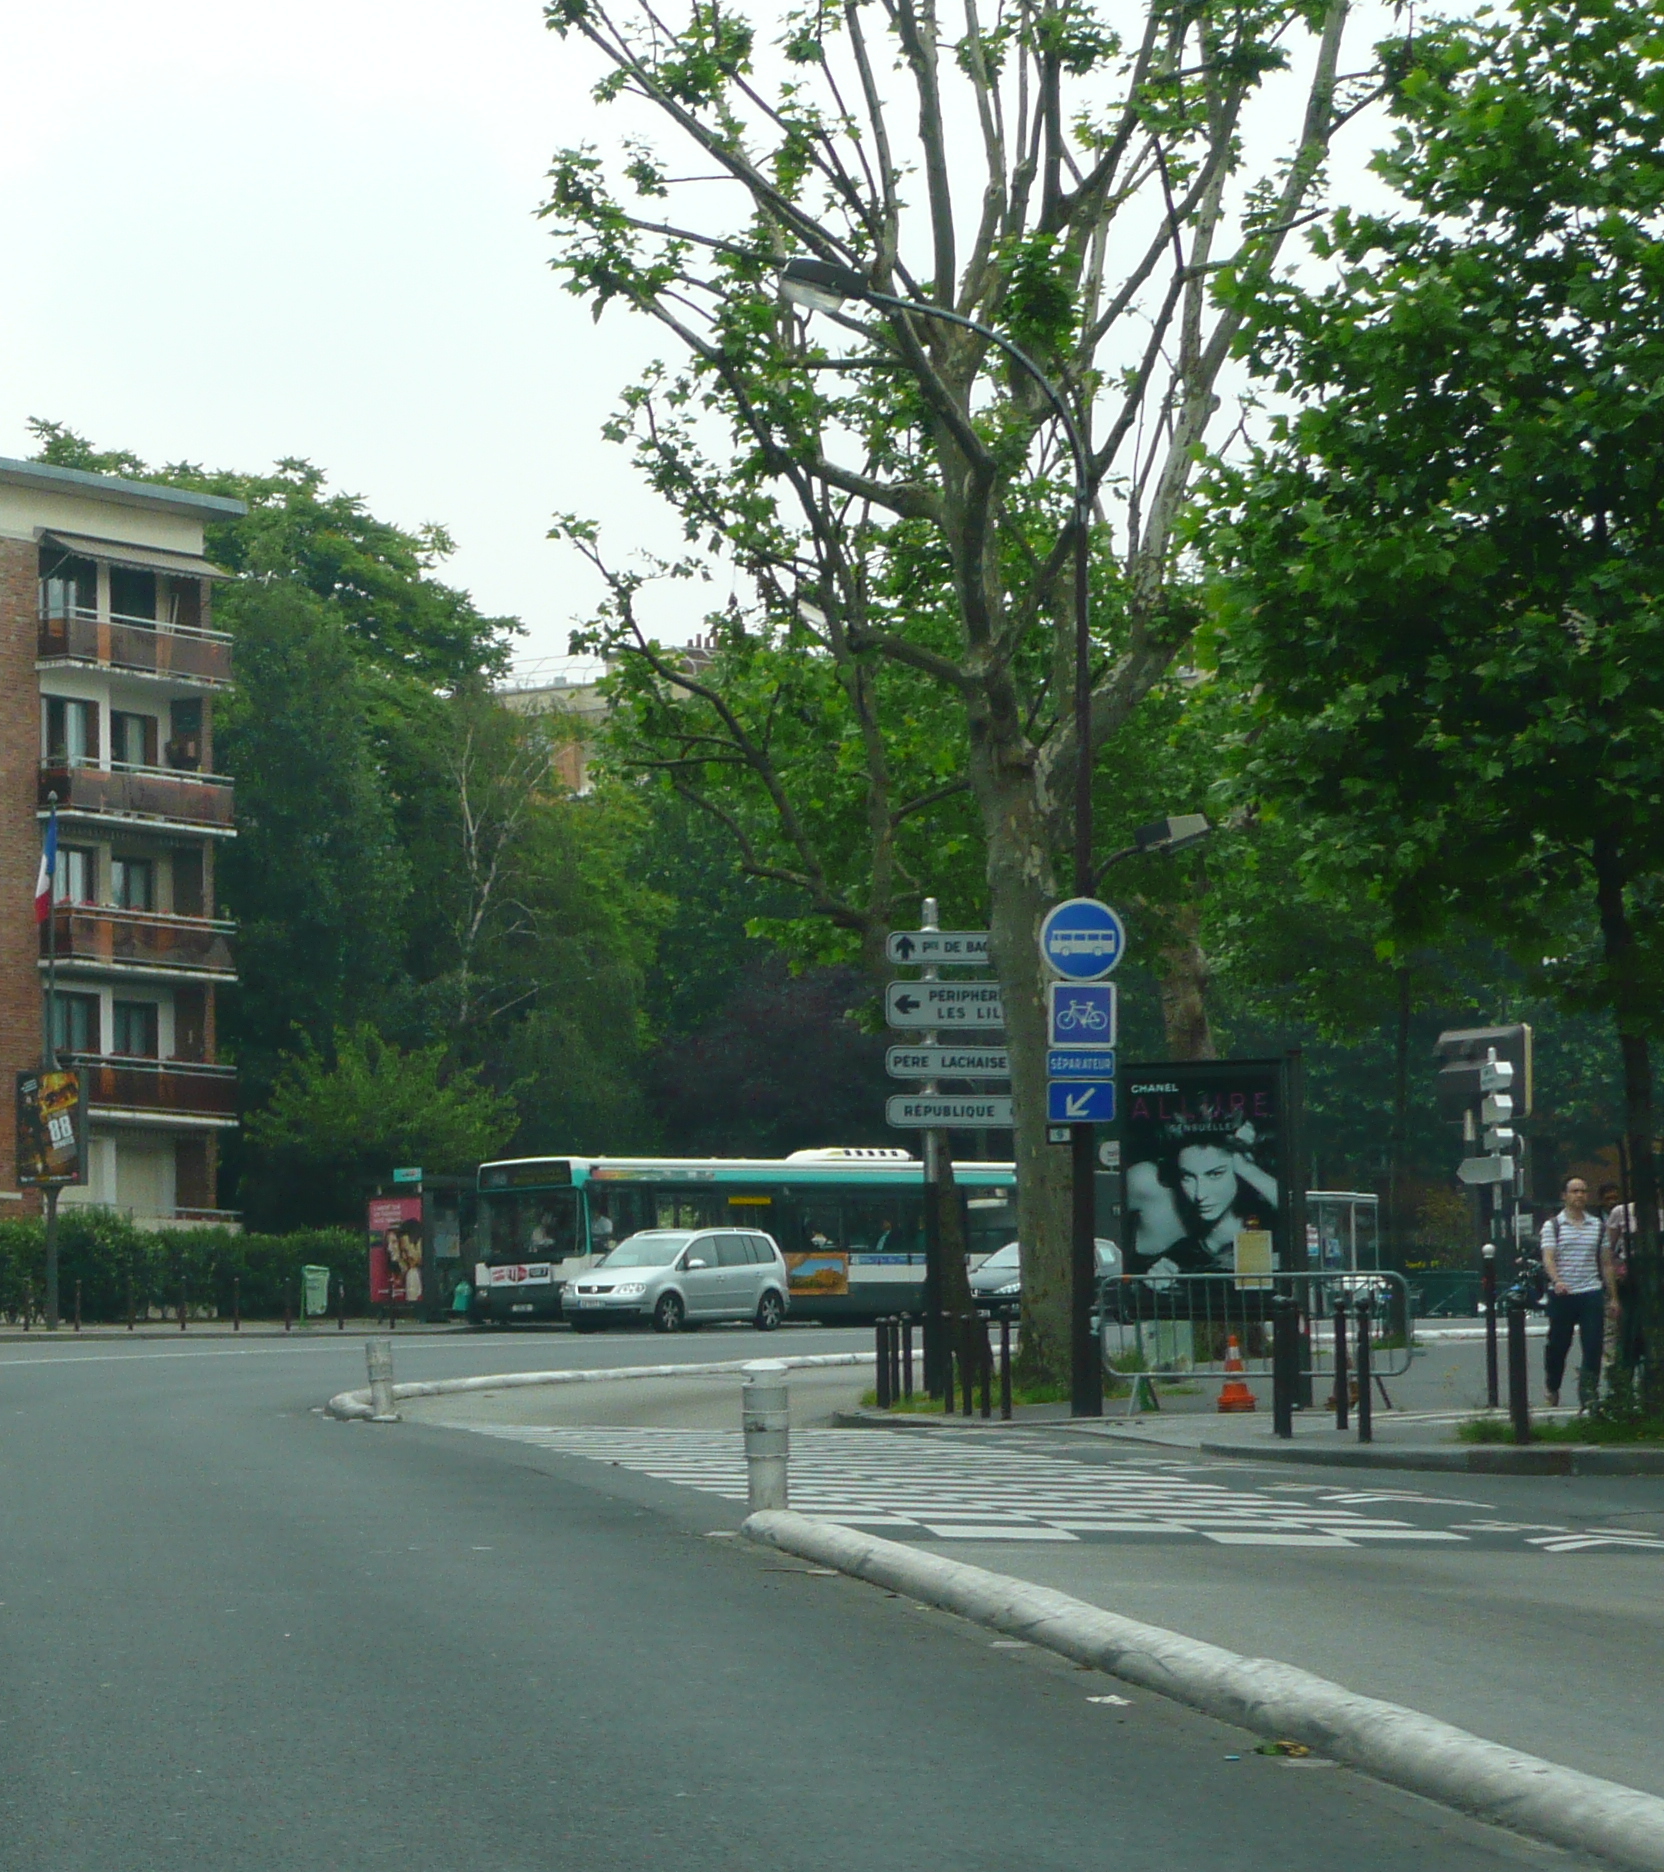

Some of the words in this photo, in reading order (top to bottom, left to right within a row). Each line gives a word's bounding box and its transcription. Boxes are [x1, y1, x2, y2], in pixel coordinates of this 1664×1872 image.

[944, 941, 961, 953] DE
[938, 1007, 966, 1020] LES
[977, 1007, 1001, 1020] LIL
[941, 1056, 1007, 1069] LACHAISE
[1050, 1057, 1112, 1070] SÉPARATEUR
[1131, 1083, 1179, 1094] CHANEL
[904, 1103, 996, 1119] RÉPUBLIQUE
[1132, 1092, 1269, 1120] ALLURE
[48, 1115, 74, 1142] 88
